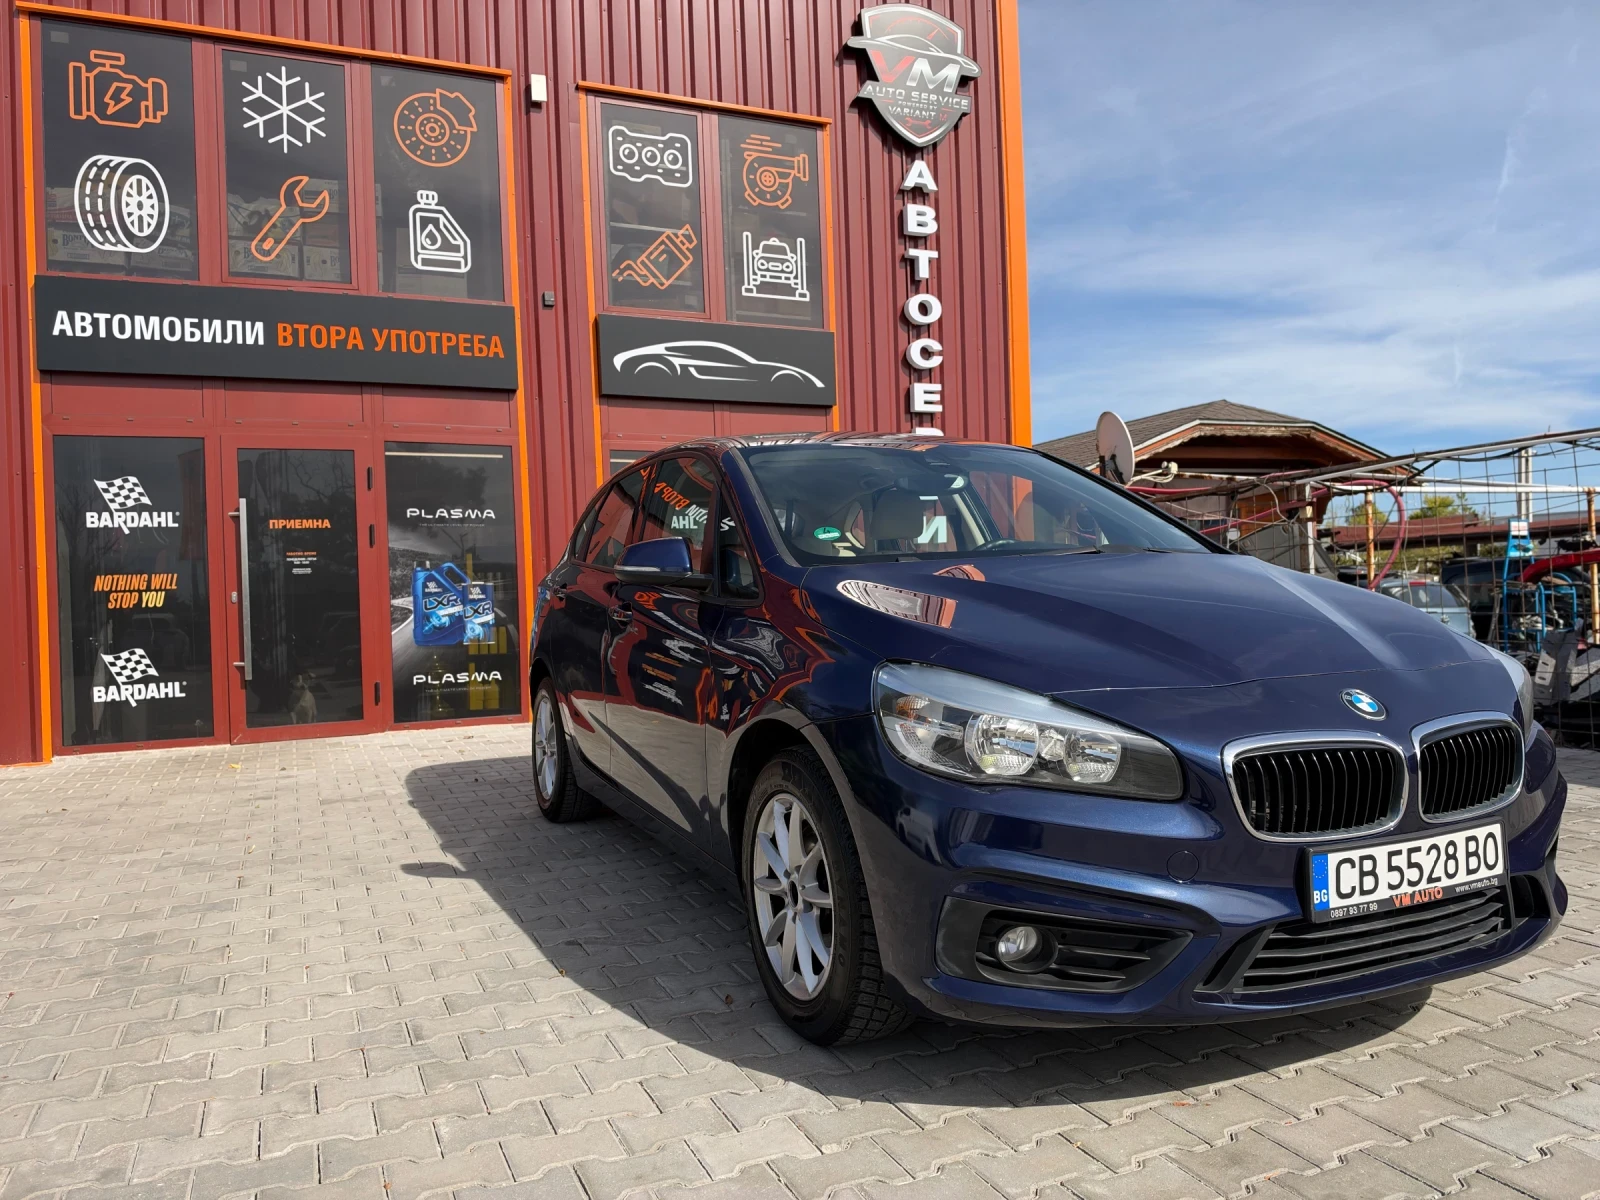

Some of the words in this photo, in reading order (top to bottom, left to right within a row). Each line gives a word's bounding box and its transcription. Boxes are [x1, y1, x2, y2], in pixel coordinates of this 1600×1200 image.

[870, 50, 961, 93] VM
[863, 84, 906, 100] AUTO
[911, 91, 969, 110] SERVICE
[898, 101, 928, 109] POWERED
[888, 105, 937, 120] VARIANT
[902, 160, 944, 436] АВТОСЕ
[52, 310, 265, 346] АВТОМОБИЛИ
[277, 322, 365, 351] ВТОРА
[371, 327, 505, 359] УПОТРЕБА
[85, 511, 179, 534] BARDAHL
[406, 508, 496, 519] PLASMA
[269, 519, 331, 529] ПРИЕМНА
[93, 574, 148, 592] NOTHING
[150, 573, 178, 590] WILL
[107, 592, 139, 609] STOP
[141, 591, 166, 608] YOU
[423, 592, 462, 612] LXR
[463, 601, 493, 620] LXR
[413, 671, 502, 686] PLASMA
[93, 682, 186, 707] BARDAHL
[1335, 853, 1379, 900] CB
[1387, 839, 1459, 891] 5528
[1465, 831, 1499, 876] BO
[1455, 877, 1498, 893] www.vmauto.bg
[1313, 889, 1328, 904] BG
[1390, 893, 1411, 908] VM
[1413, 886, 1444, 904] AUTO
[1330, 908, 1348, 919] 0897
[1349, 906, 1358, 915] 93
[1359, 904, 1368, 913] 77
[1369, 902, 1378, 912] 99
